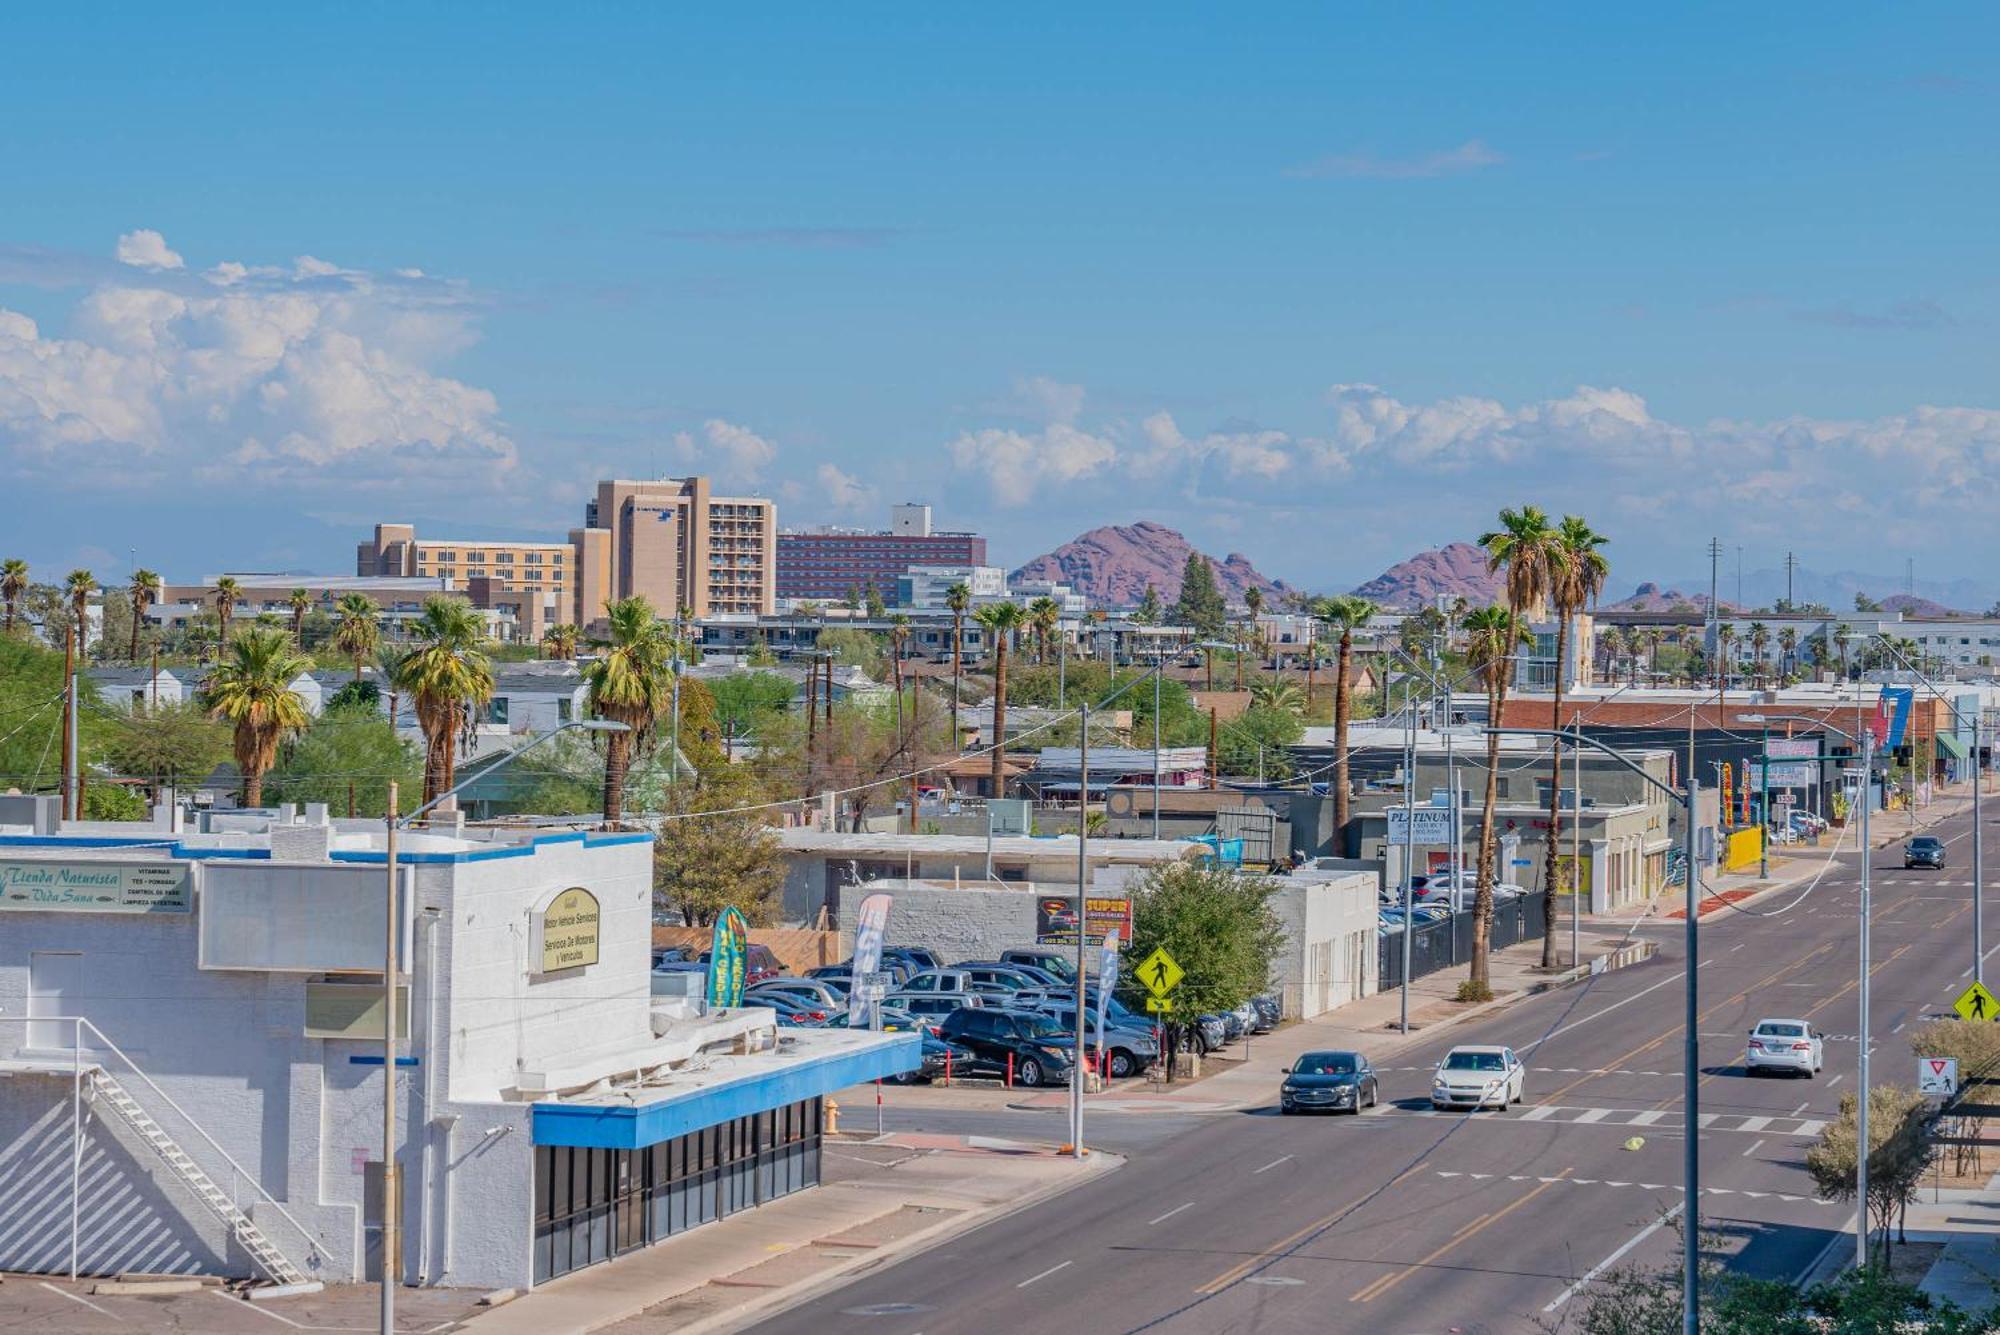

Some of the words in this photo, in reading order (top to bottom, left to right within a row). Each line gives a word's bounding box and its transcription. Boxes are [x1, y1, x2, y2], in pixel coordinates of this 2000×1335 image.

[1391, 812, 1450, 822] PLTINUM
[6, 866, 53, 884] Tienda
[55, 867, 118, 885] Naturista
[31, 887, 59, 902] Vida
[58, 885, 94, 903] Sana
[1087, 899, 1127, 912] SUPER
[576, 912, 597, 924] Services
